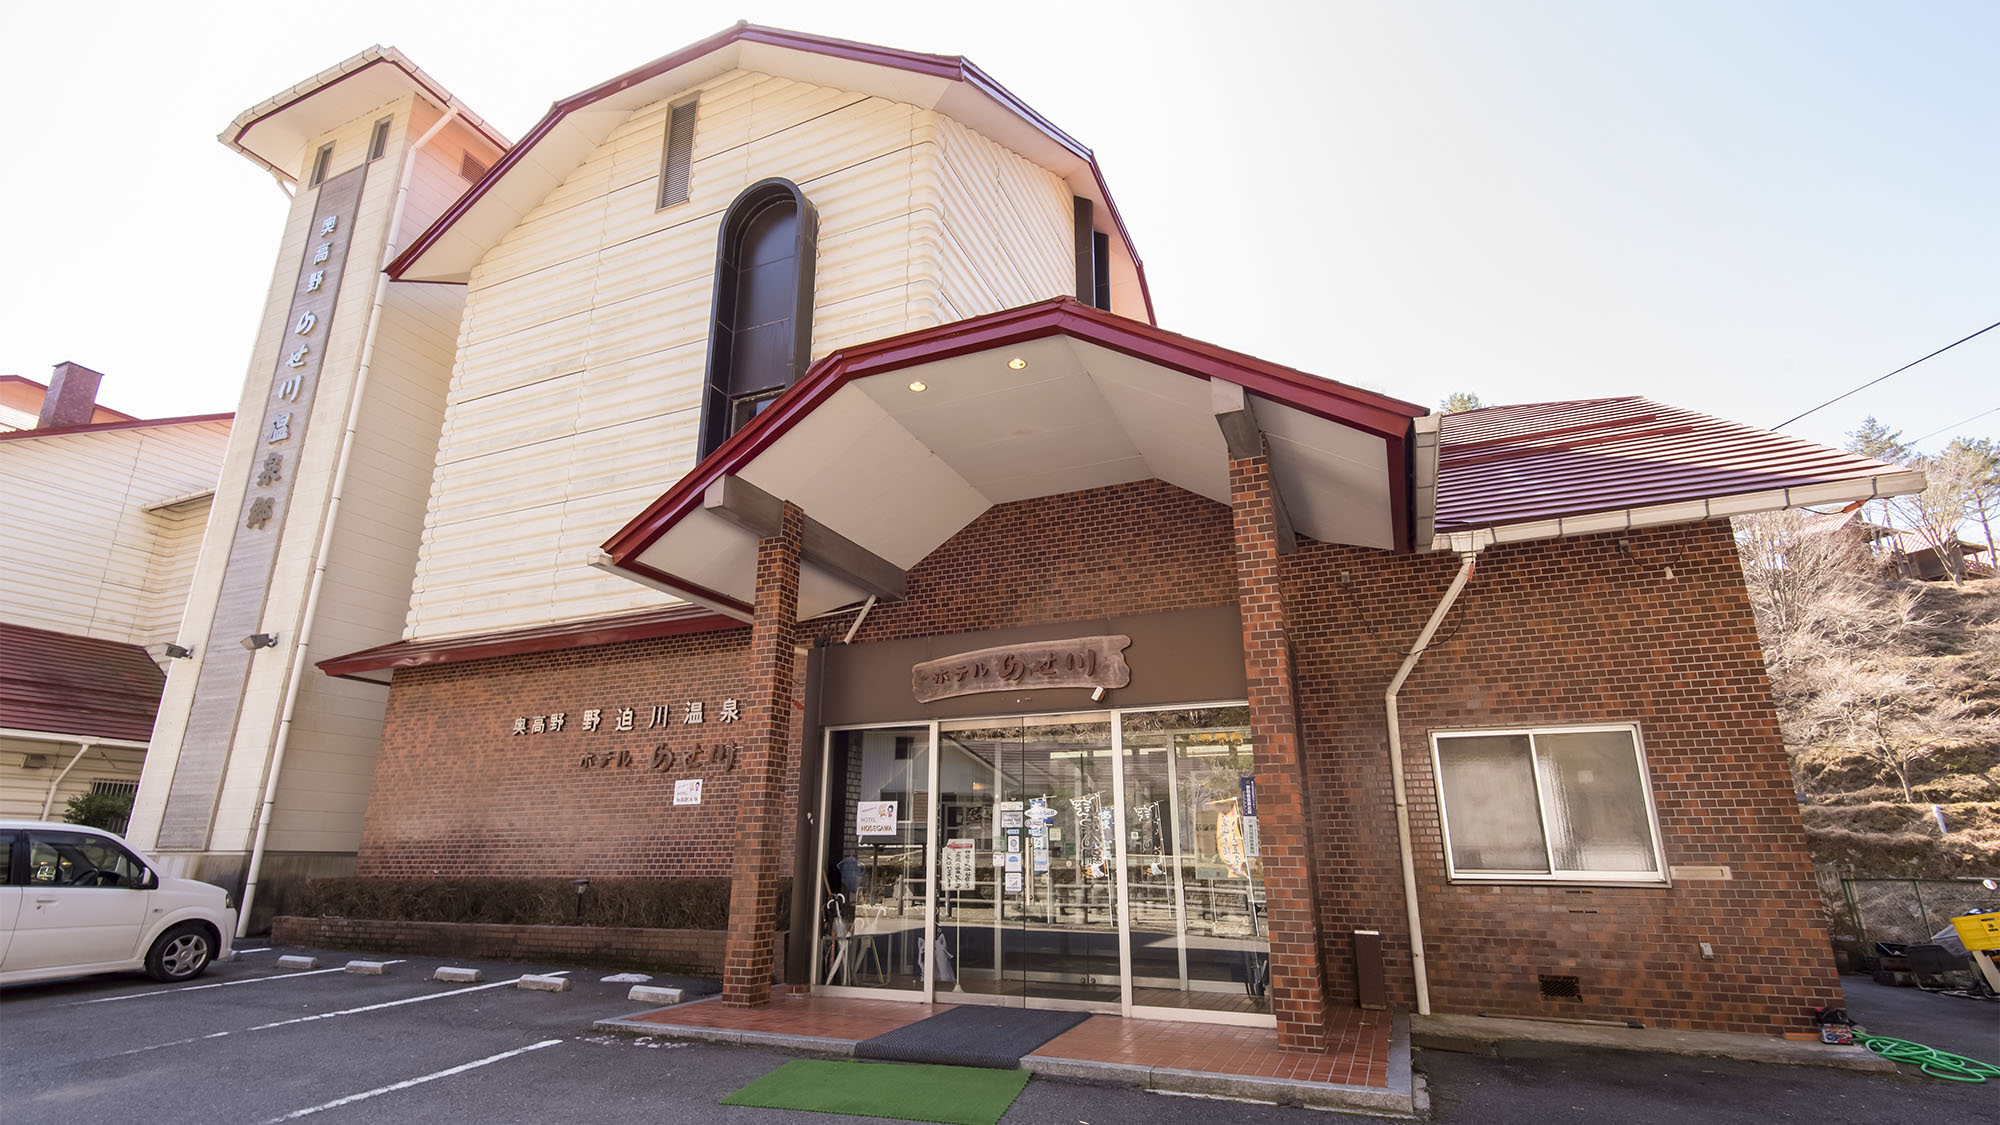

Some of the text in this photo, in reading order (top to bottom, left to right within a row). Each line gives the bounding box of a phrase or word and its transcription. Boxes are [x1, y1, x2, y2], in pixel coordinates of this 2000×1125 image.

[306, 215, 338, 293] 奥高野
[512, 698, 741, 736] 奥高野 野迫川温泉
